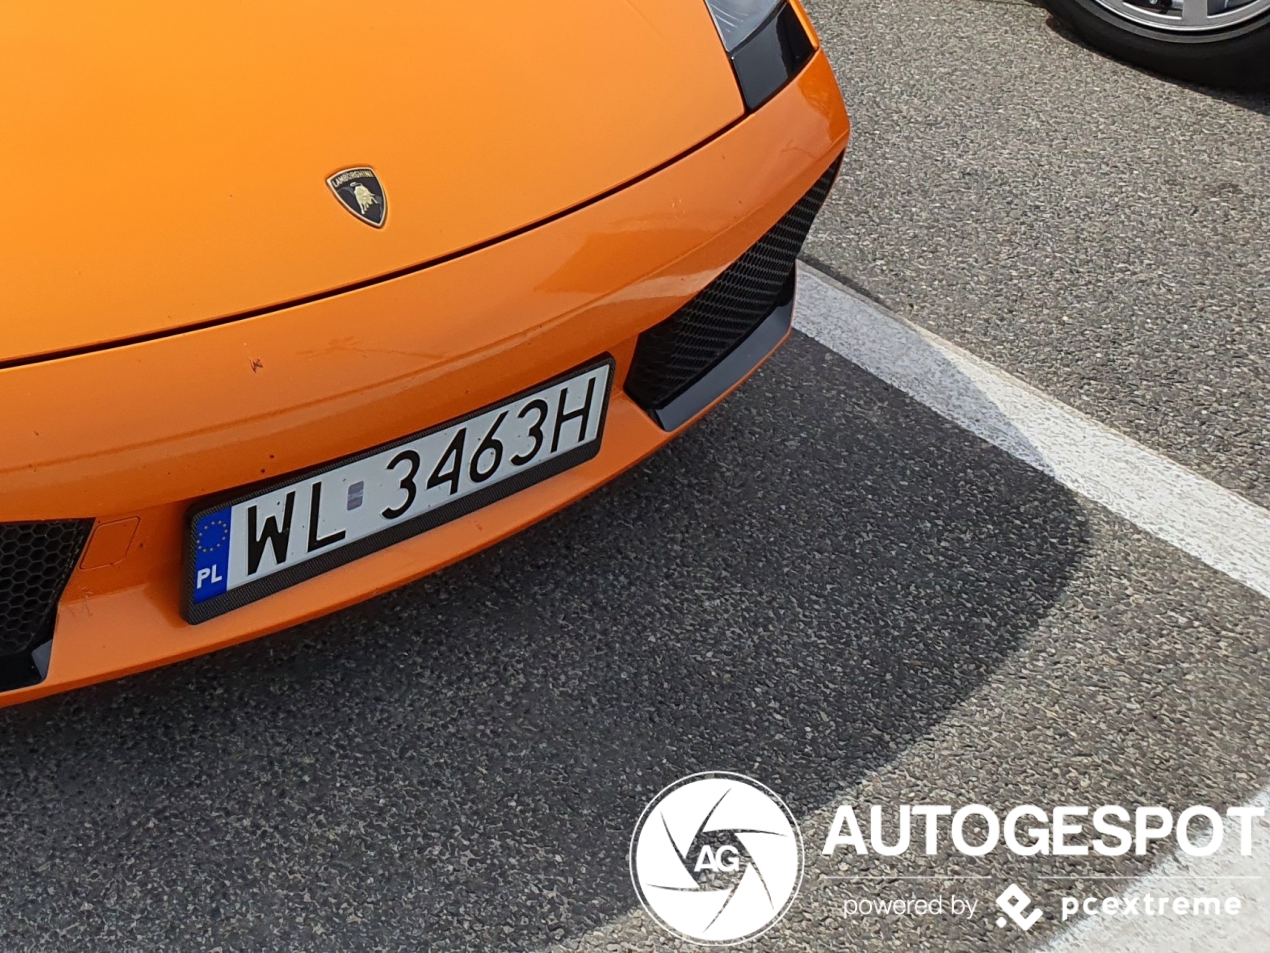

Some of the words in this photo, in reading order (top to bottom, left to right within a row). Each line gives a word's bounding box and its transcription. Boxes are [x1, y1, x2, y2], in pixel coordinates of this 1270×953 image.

[332, 170, 374, 188] LAMBORGHINI
[246, 481, 346, 576] WL
[380, 377, 596, 520] 3463H
[196, 564, 222, 589] PL
